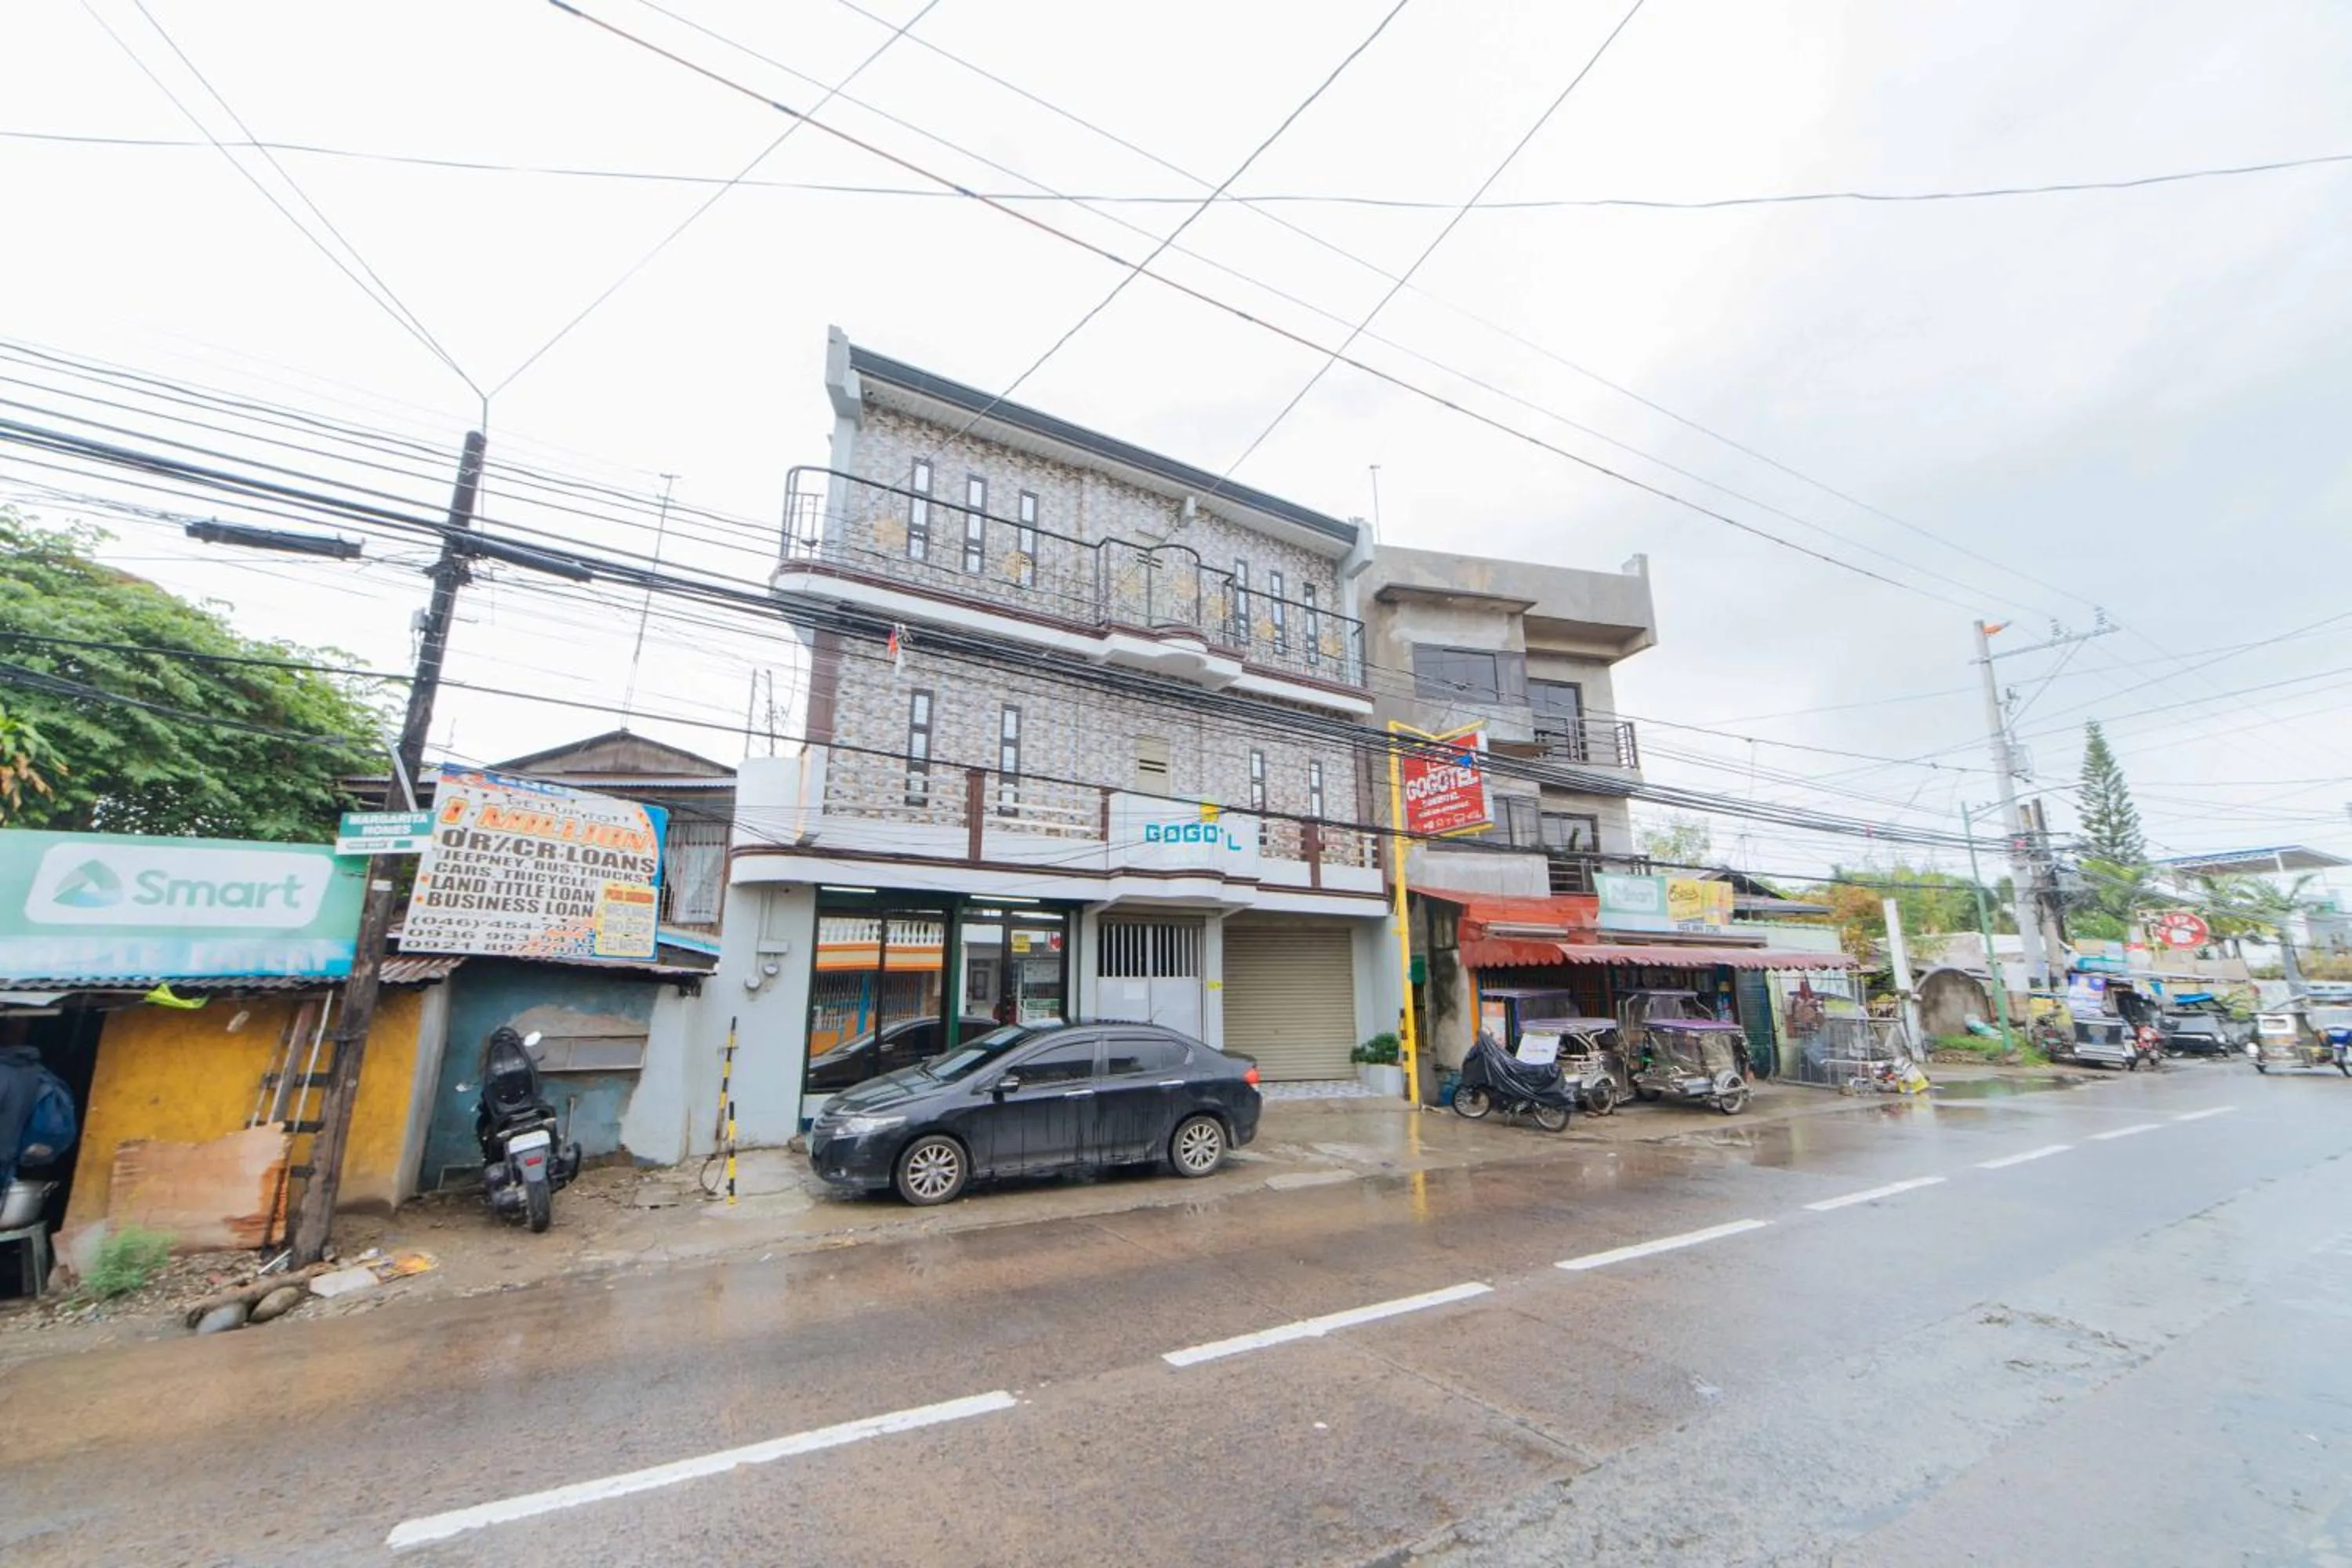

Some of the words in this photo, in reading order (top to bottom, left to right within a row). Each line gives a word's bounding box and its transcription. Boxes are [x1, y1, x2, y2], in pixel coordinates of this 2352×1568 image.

[348, 814, 428, 826] MARGARITA
[361, 824, 412, 836] HOMES
[475, 802, 652, 854] MILLION
[566, 845, 656, 874] LOANS
[132, 869, 304, 909] Smart
[431, 874, 487, 895] LAND
[493, 880, 545, 899] TITLE
[550, 887, 595, 902] LOAN
[426, 891, 540, 914] BUSINESS
[546, 902, 594, 918] LOAN
[411, 916, 480, 929] (046)
